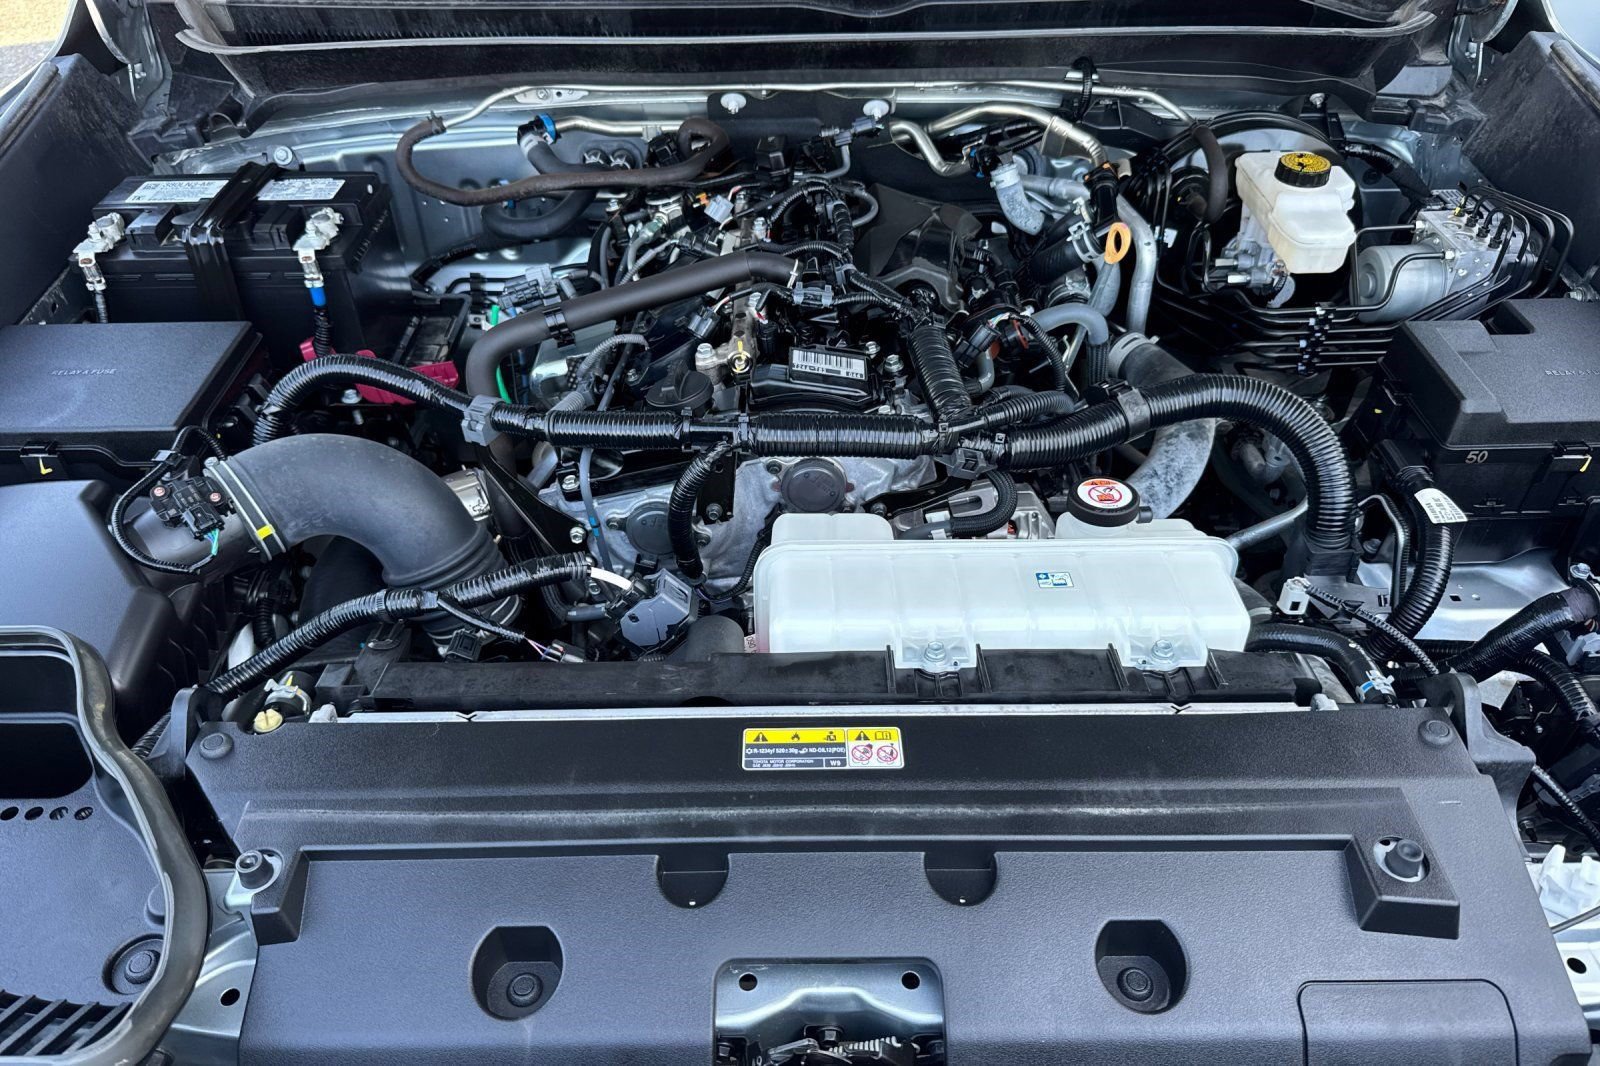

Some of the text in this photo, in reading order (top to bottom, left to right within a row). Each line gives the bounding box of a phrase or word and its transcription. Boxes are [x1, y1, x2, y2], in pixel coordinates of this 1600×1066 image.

[1465, 450, 1489, 464] 50
[753, 747, 775, 755] R-1234yf
[829, 759, 842, 767] W9
